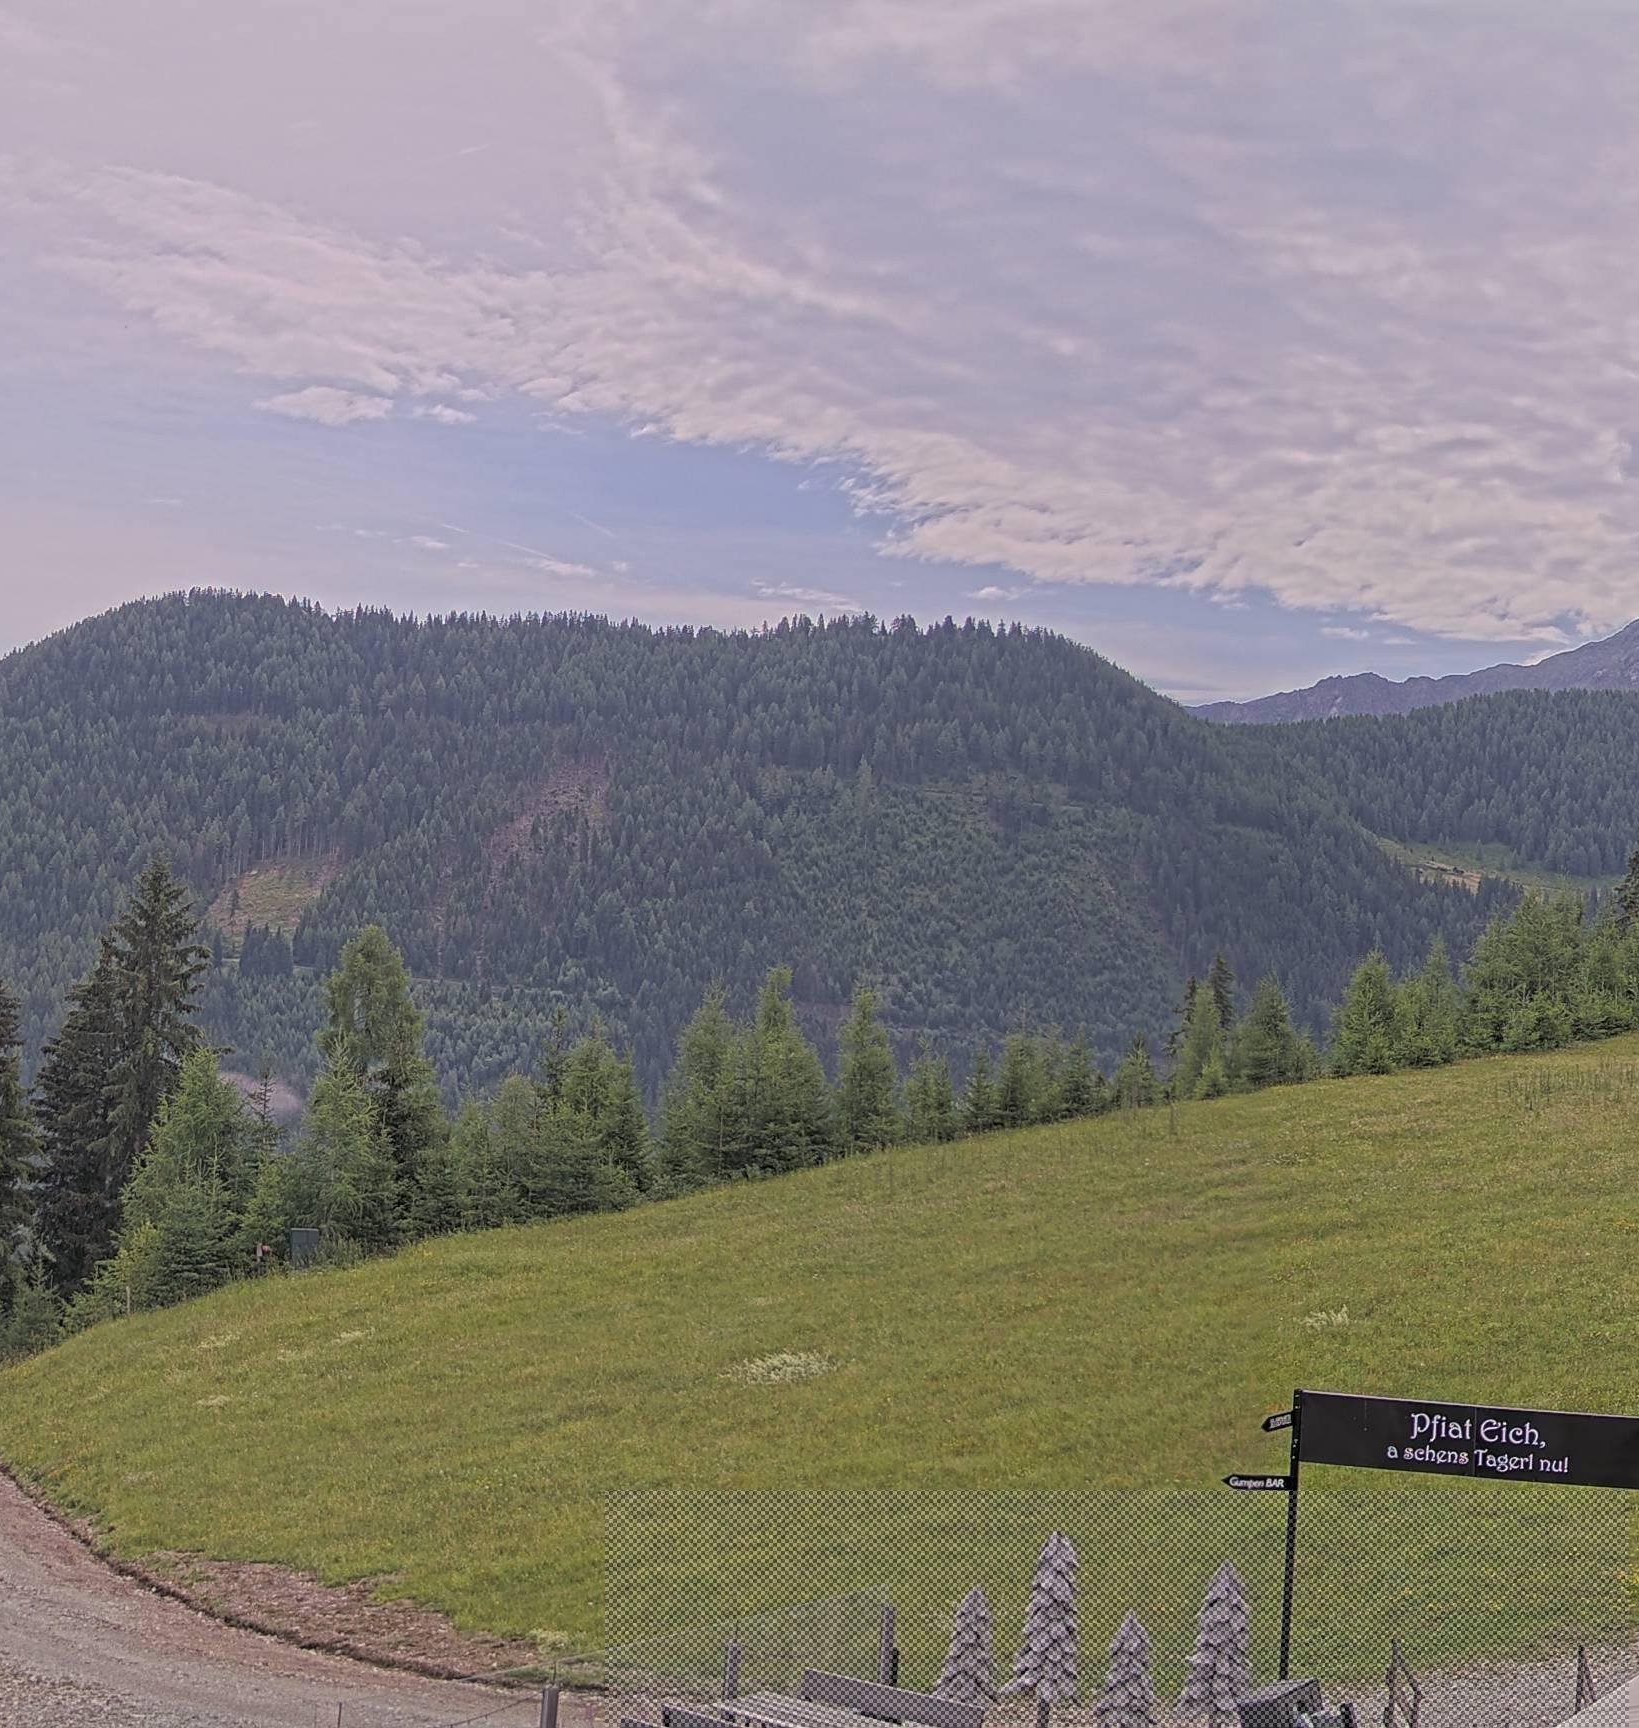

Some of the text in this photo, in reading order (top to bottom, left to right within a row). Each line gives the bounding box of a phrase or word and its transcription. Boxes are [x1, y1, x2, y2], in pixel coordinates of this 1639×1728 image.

[1410, 1412, 1546, 1449] Pfiat Eich,
[1387, 1445, 1569, 1473] a schens Tagerl nu!
[1229, 1476, 1284, 1489] Gumpen BAR
